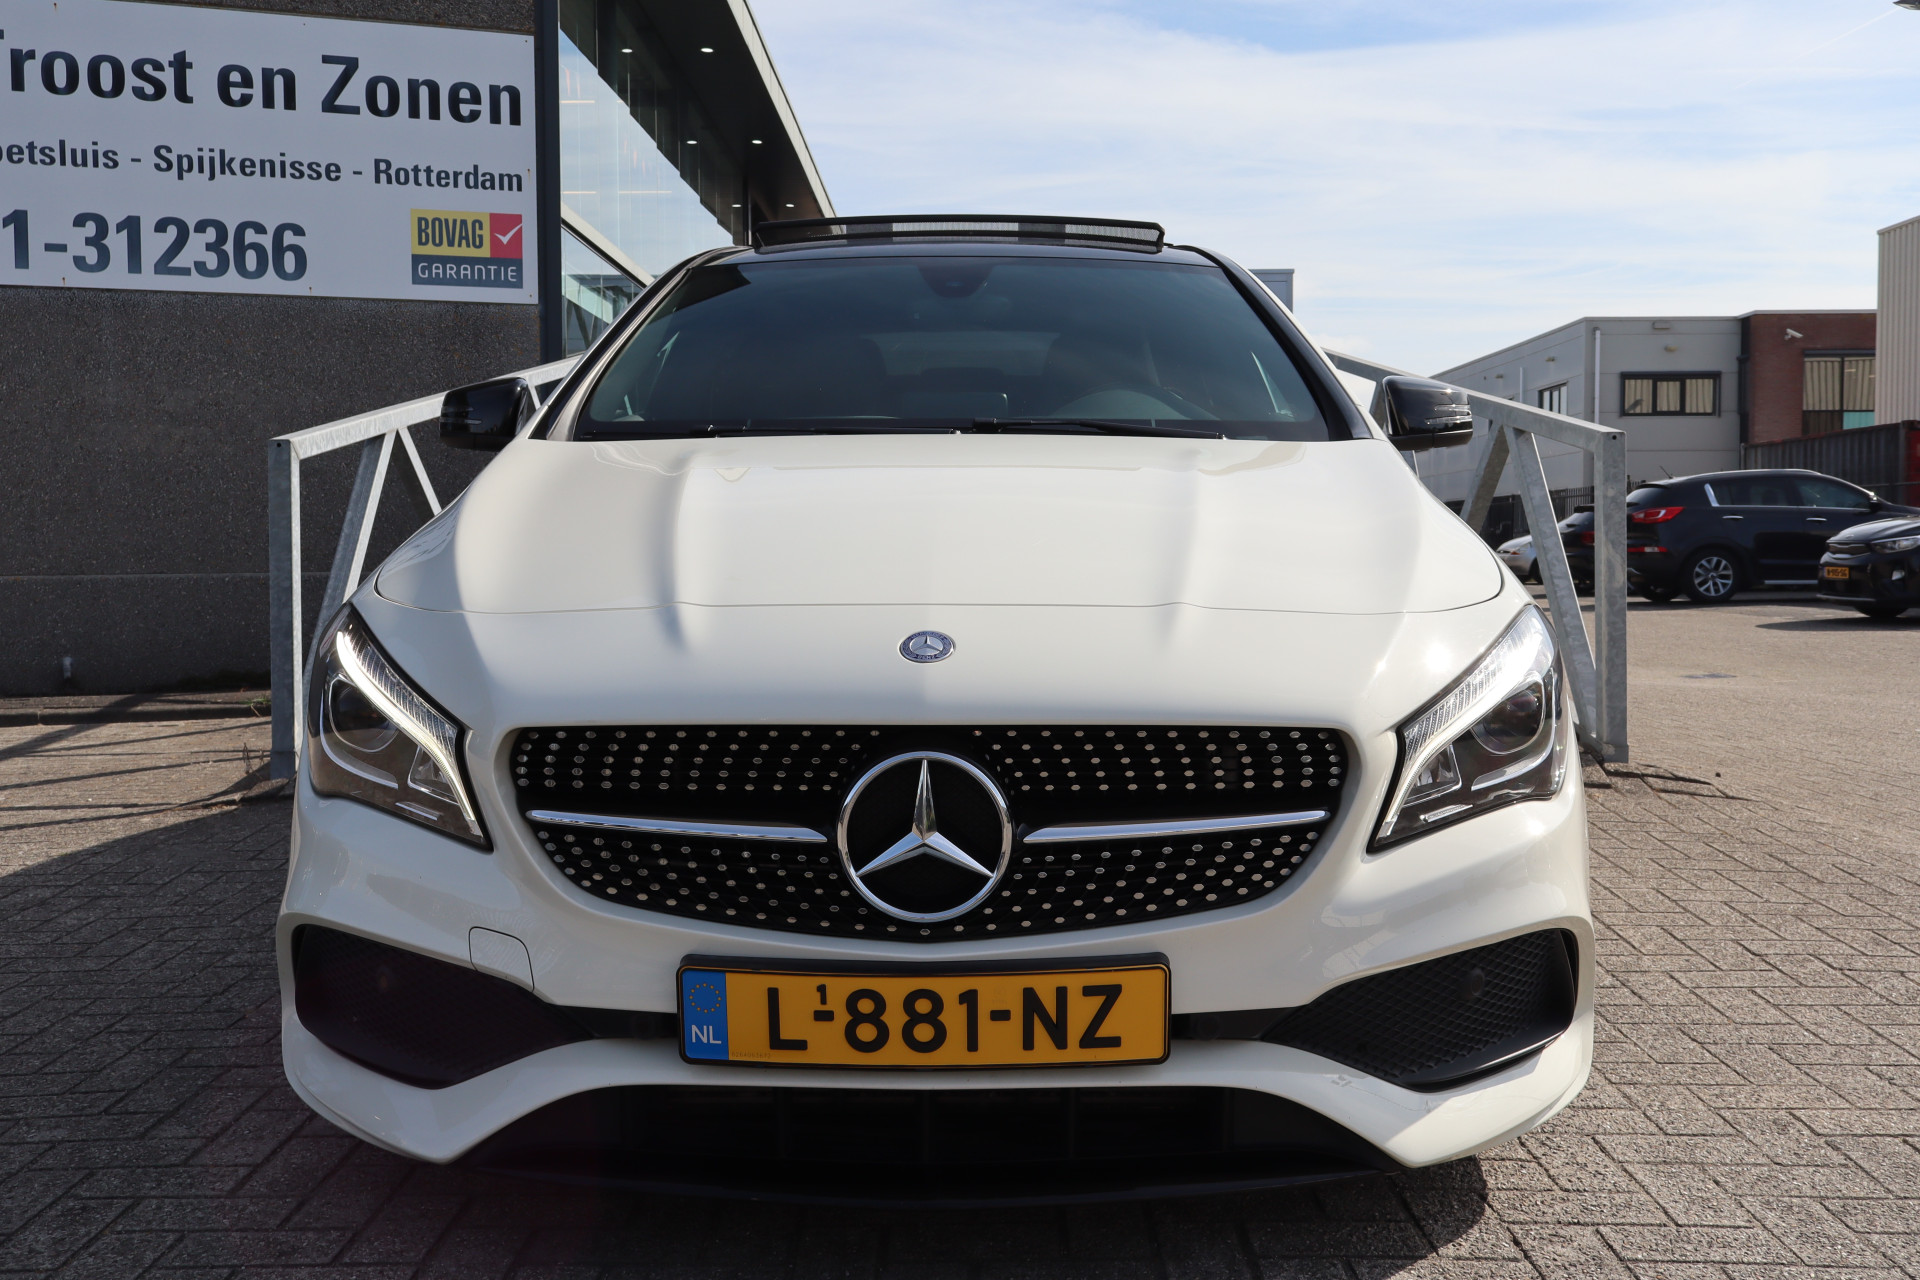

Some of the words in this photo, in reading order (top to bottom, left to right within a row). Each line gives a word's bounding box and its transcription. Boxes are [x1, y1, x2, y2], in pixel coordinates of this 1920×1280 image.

[0, 29, 194, 104] roost
[216, 63, 297, 111] en
[321, 54, 522, 126] Zonen
[0, 139, 120, 170] etsluis
[153, 144, 342, 181] Spijkenisse
[373, 158, 523, 192] Rotterdam
[2, 208, 308, 282] 1-312366
[417, 216, 484, 249] BOVAG
[417, 262, 517, 282] GARANTIE
[691, 1024, 722, 1044] NL
